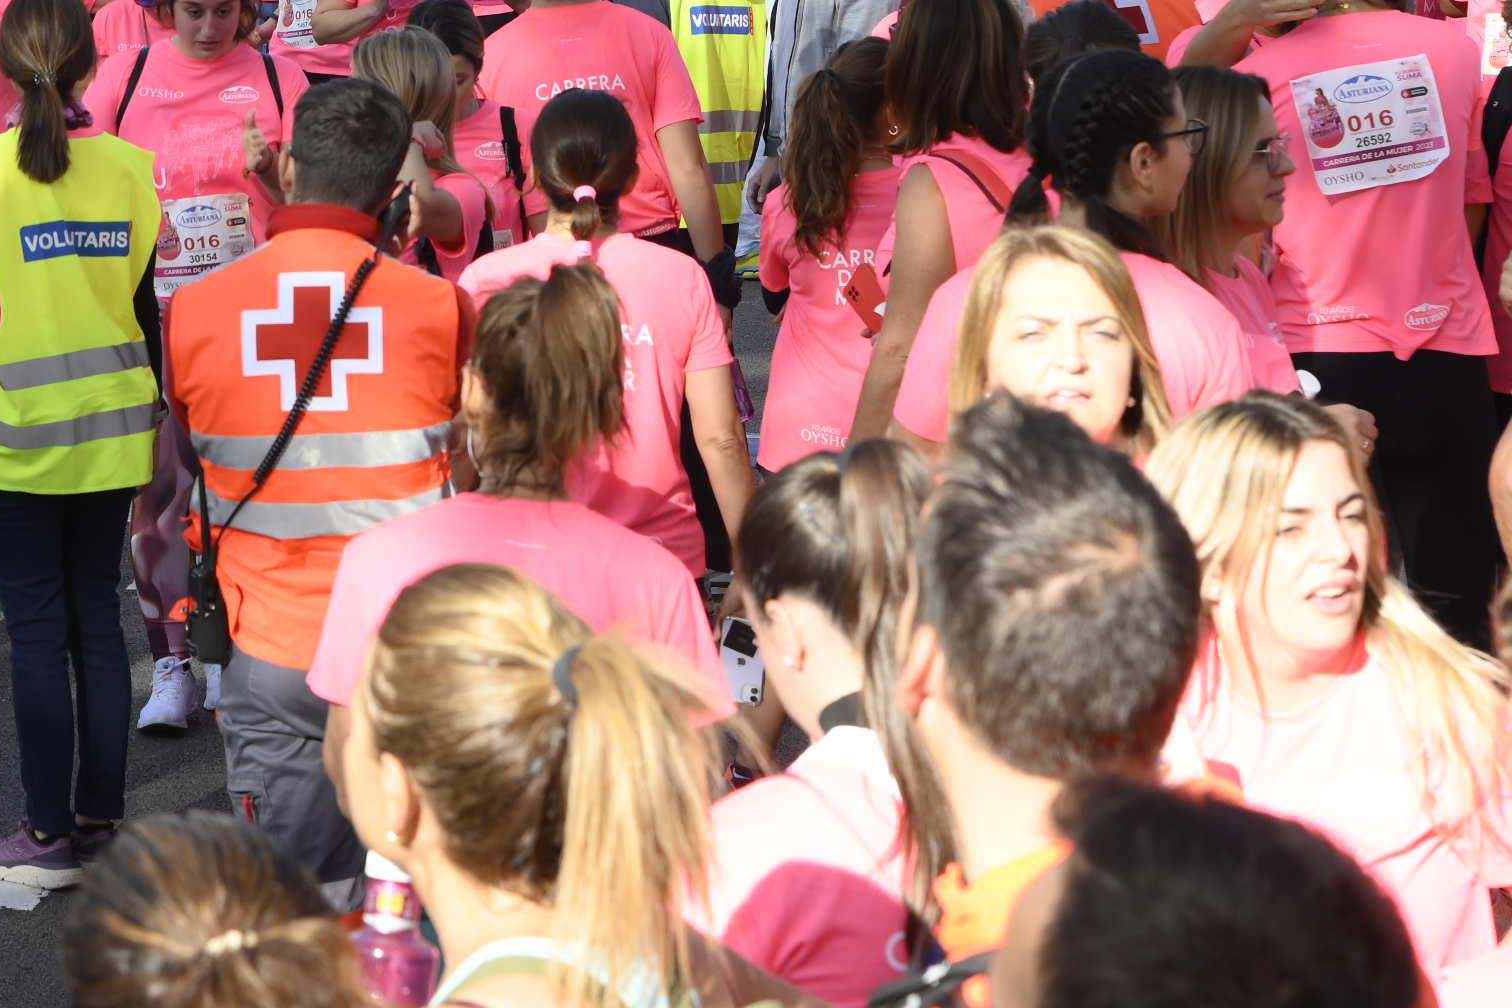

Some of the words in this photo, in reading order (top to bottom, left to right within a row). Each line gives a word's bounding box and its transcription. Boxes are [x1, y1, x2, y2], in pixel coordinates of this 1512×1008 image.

[1396, 71, 1424, 82] SUMA
[139, 87, 184, 99] OYSHO
[1339, 85, 1390, 99] ASTURIANA
[1347, 109, 1395, 132] 016
[1355, 132, 1393, 148] 26592
[1322, 154, 1361, 167] CARRERA
[1361, 152, 1373, 161] DE
[1373, 150, 1385, 158] LA
[1386, 145, 1414, 156] MUJER
[1324, 171, 1365, 186] OYSHO
[179, 212, 219, 224] ASTURIANA
[24, 230, 129, 253] VOLUTARIS
[184, 234, 220, 252] 016
[188, 252, 218, 264] 30154
